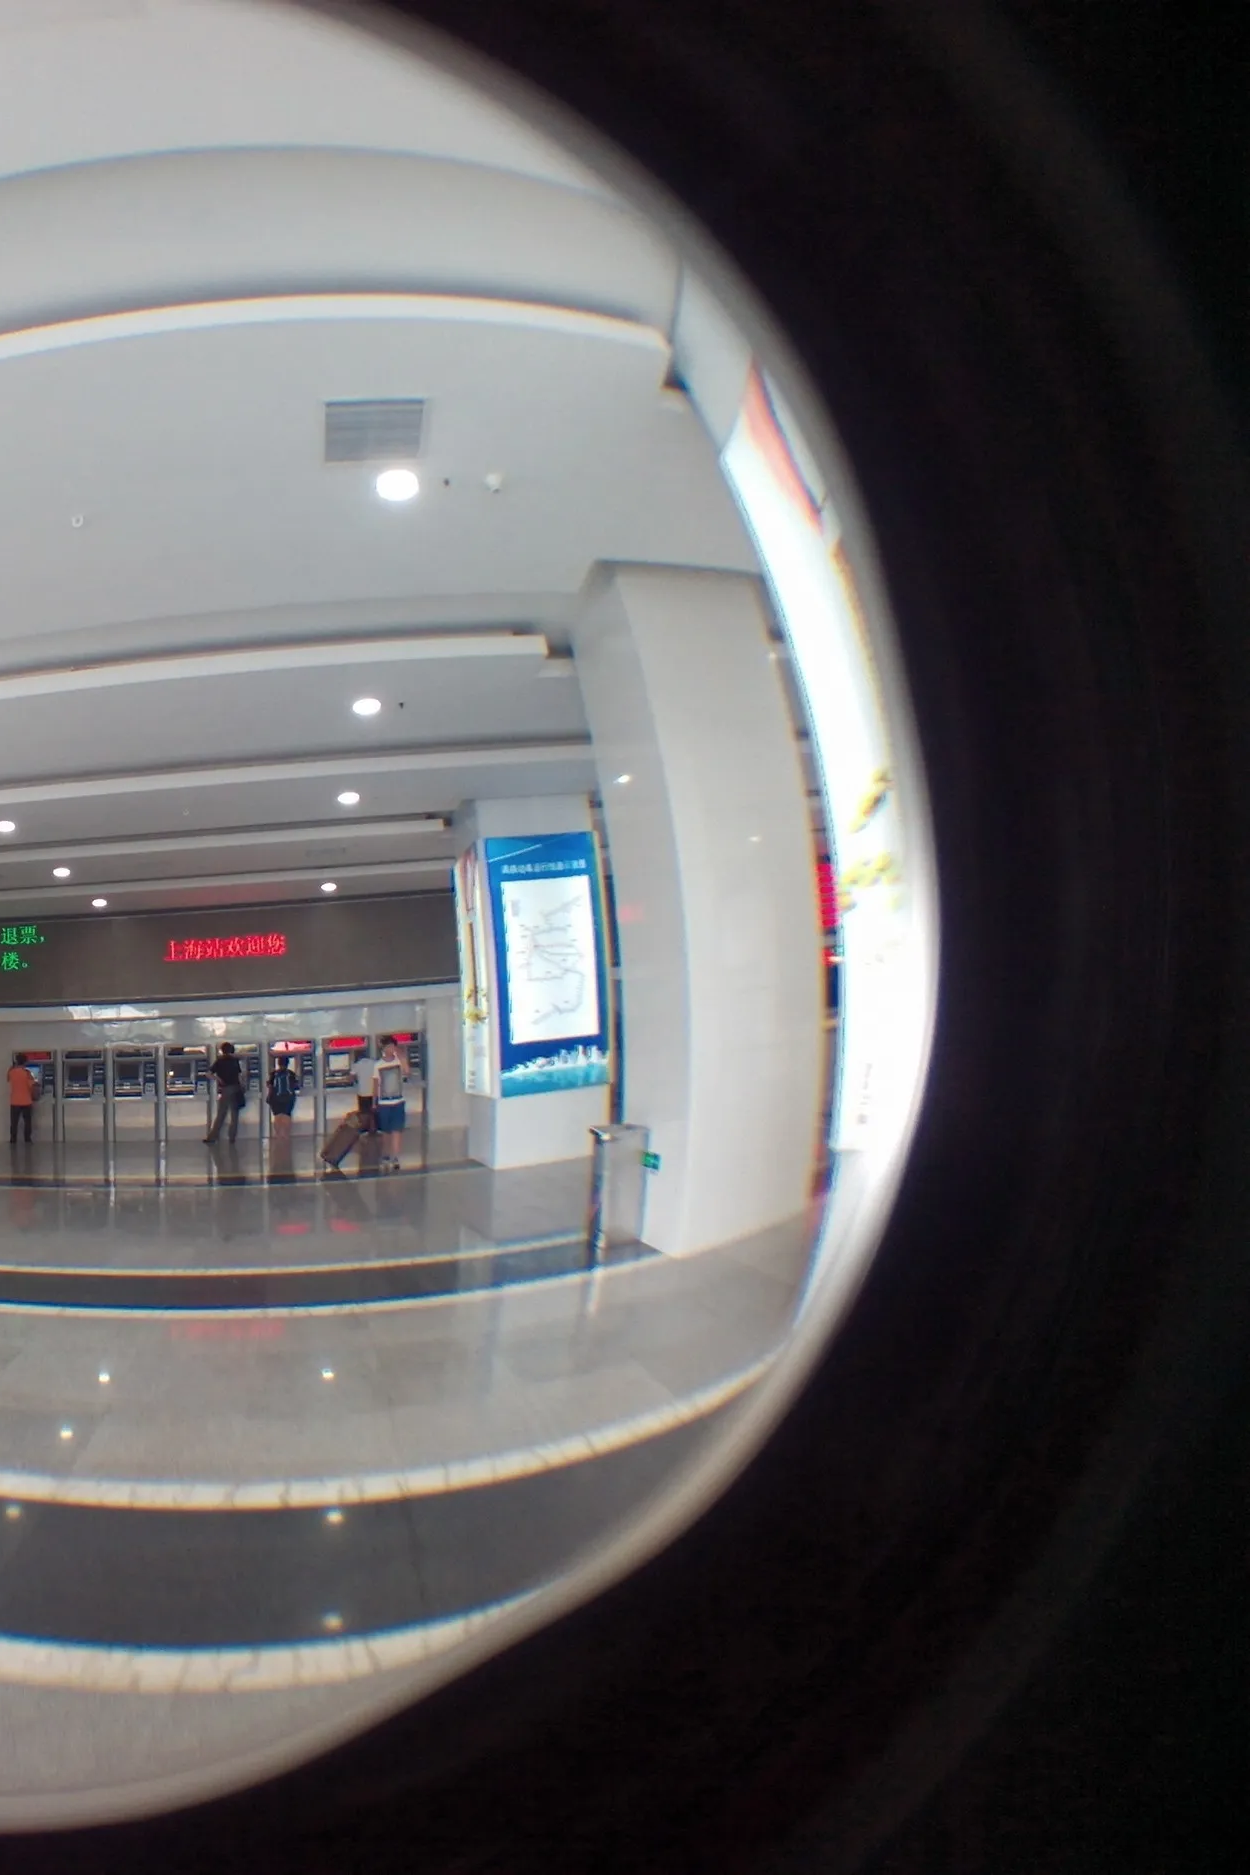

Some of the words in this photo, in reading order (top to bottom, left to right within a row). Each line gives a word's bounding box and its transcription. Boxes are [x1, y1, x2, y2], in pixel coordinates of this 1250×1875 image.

[164, 932, 287, 962] 上海站欢迎您
